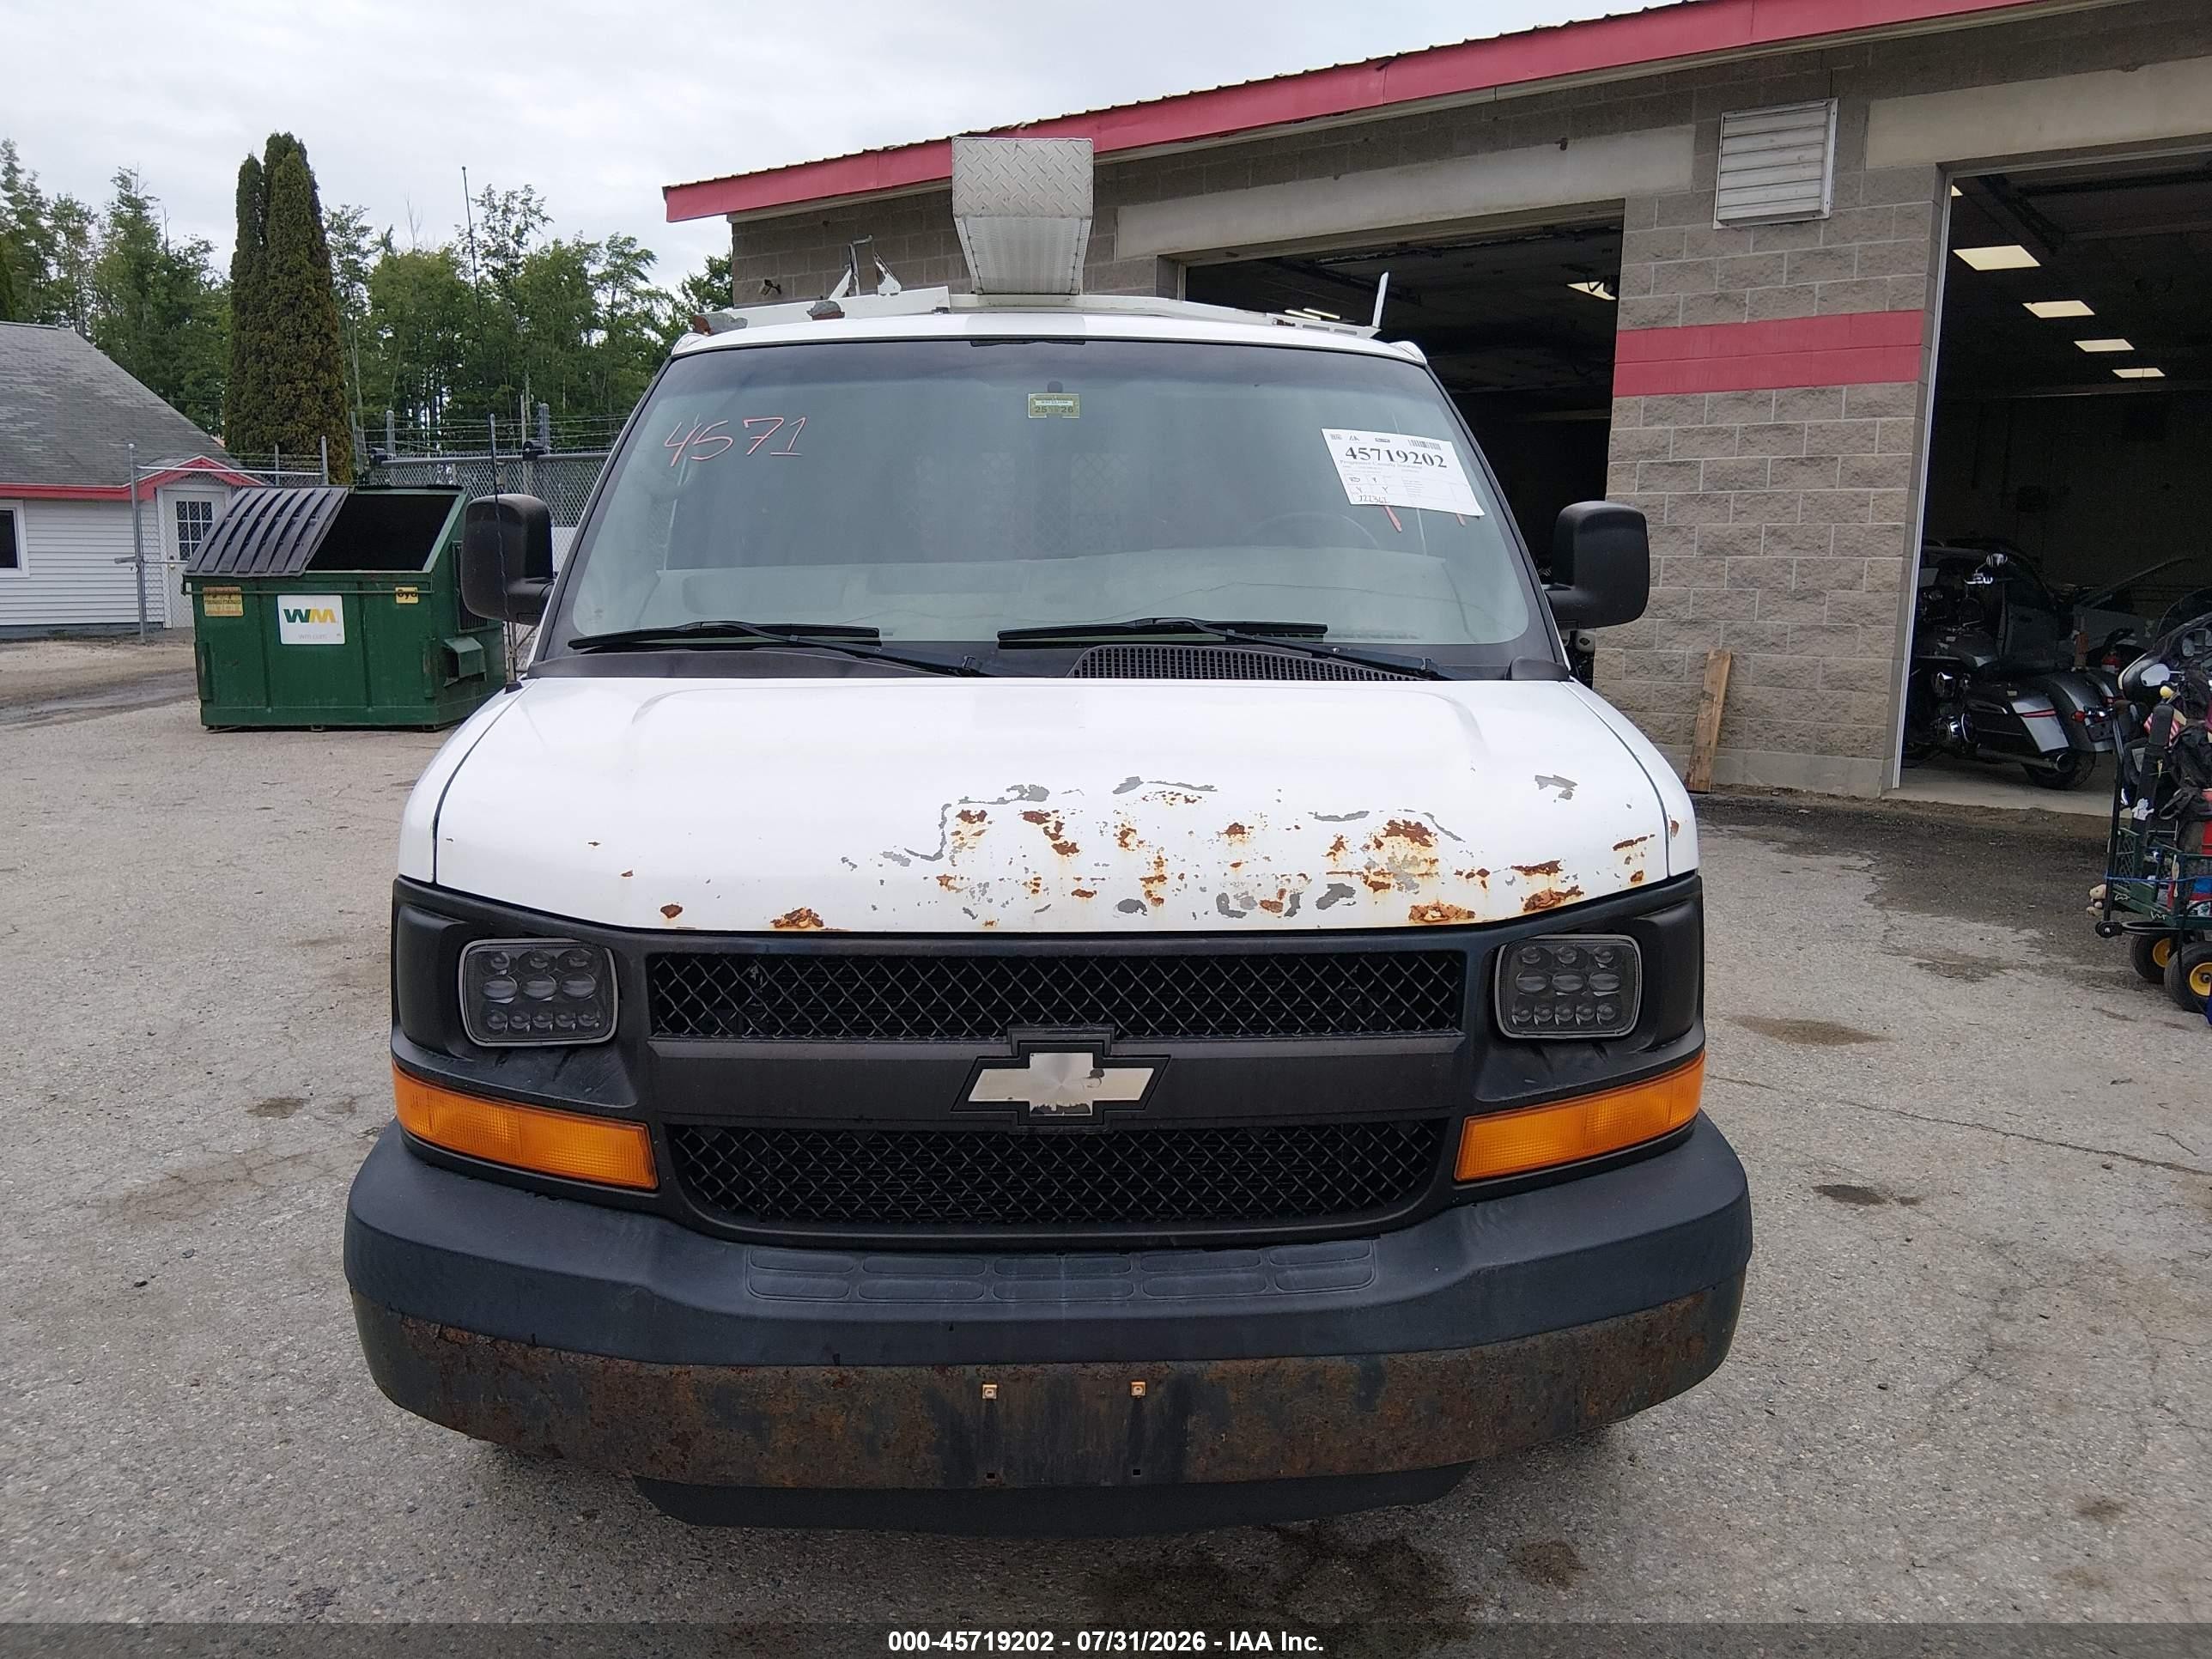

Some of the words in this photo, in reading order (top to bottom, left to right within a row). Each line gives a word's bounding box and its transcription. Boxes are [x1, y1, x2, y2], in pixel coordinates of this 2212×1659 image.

[664, 416, 808, 467] 4571
[1346, 447, 1448, 468] 45719202
[283, 608, 337, 623] WM
